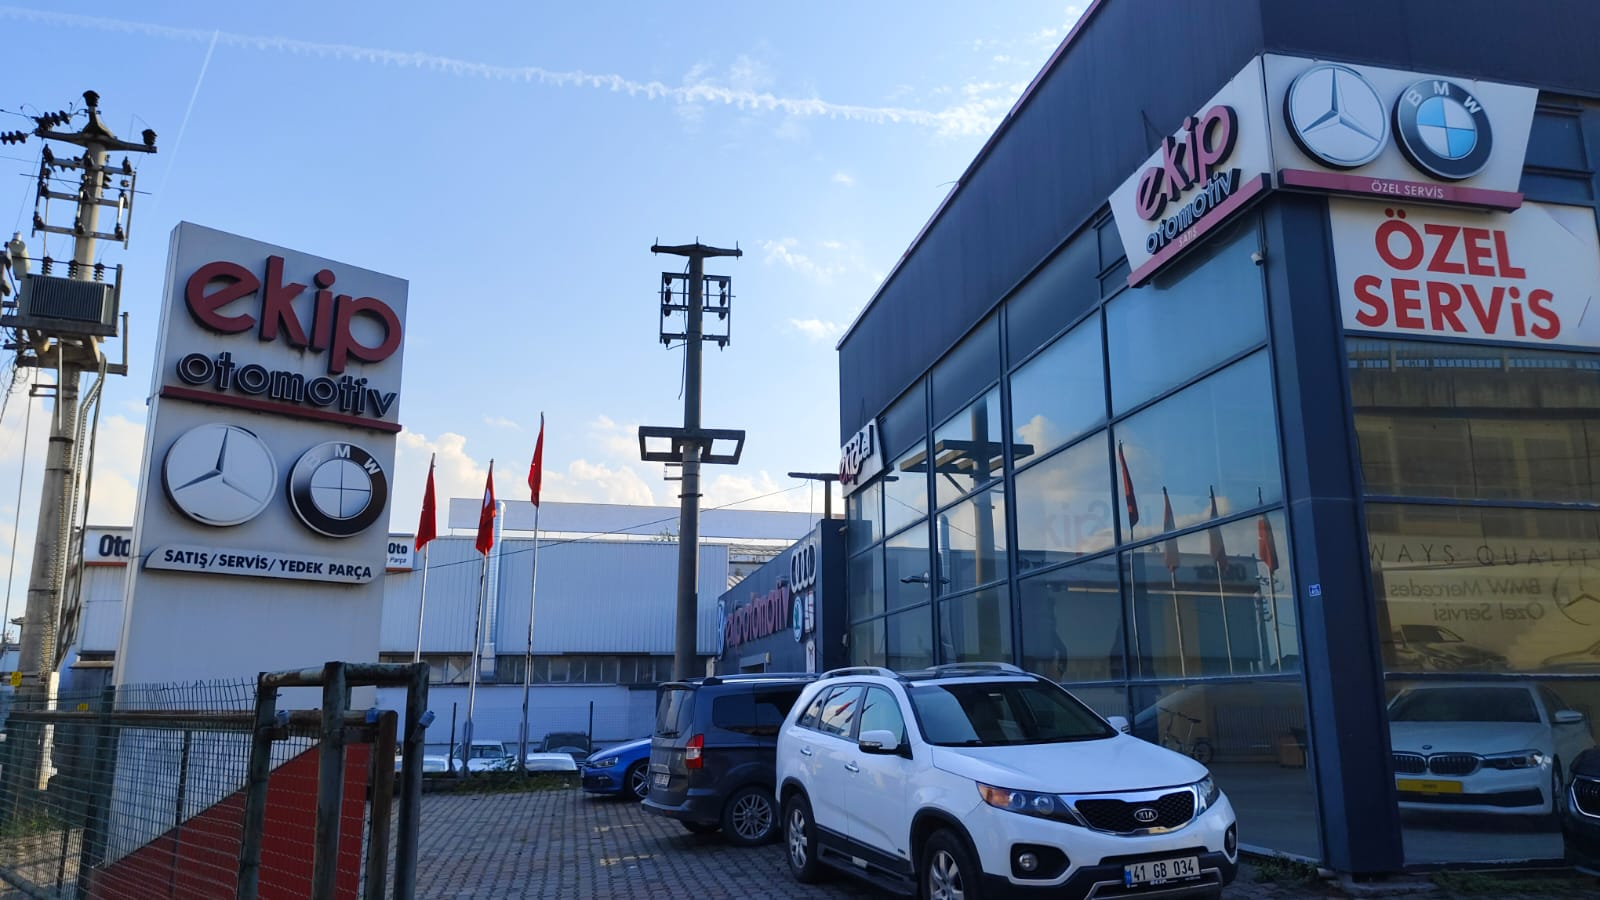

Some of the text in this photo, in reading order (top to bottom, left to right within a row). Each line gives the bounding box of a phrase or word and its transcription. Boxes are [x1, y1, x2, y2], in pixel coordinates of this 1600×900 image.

[1406, 80, 1481, 114] BMW
[1136, 105, 1238, 221] ekip
[1371, 179, 1400, 194] ÖZEL
[1146, 168, 1241, 254] otomotiv
[1375, 208, 1526, 279] ÖZEL
[185, 255, 402, 374] ekip
[176, 352, 397, 417] otomotiv
[305, 444, 380, 475] BMW
[388, 542, 407, 554] Oto
[328, 563, 372, 580] PARÇA
[1139, 811, 1155, 820] KIA
[1134, 864, 1146, 881] 41
[1153, 862, 1167, 878] GB
[1173, 858, 1194, 876] 034
